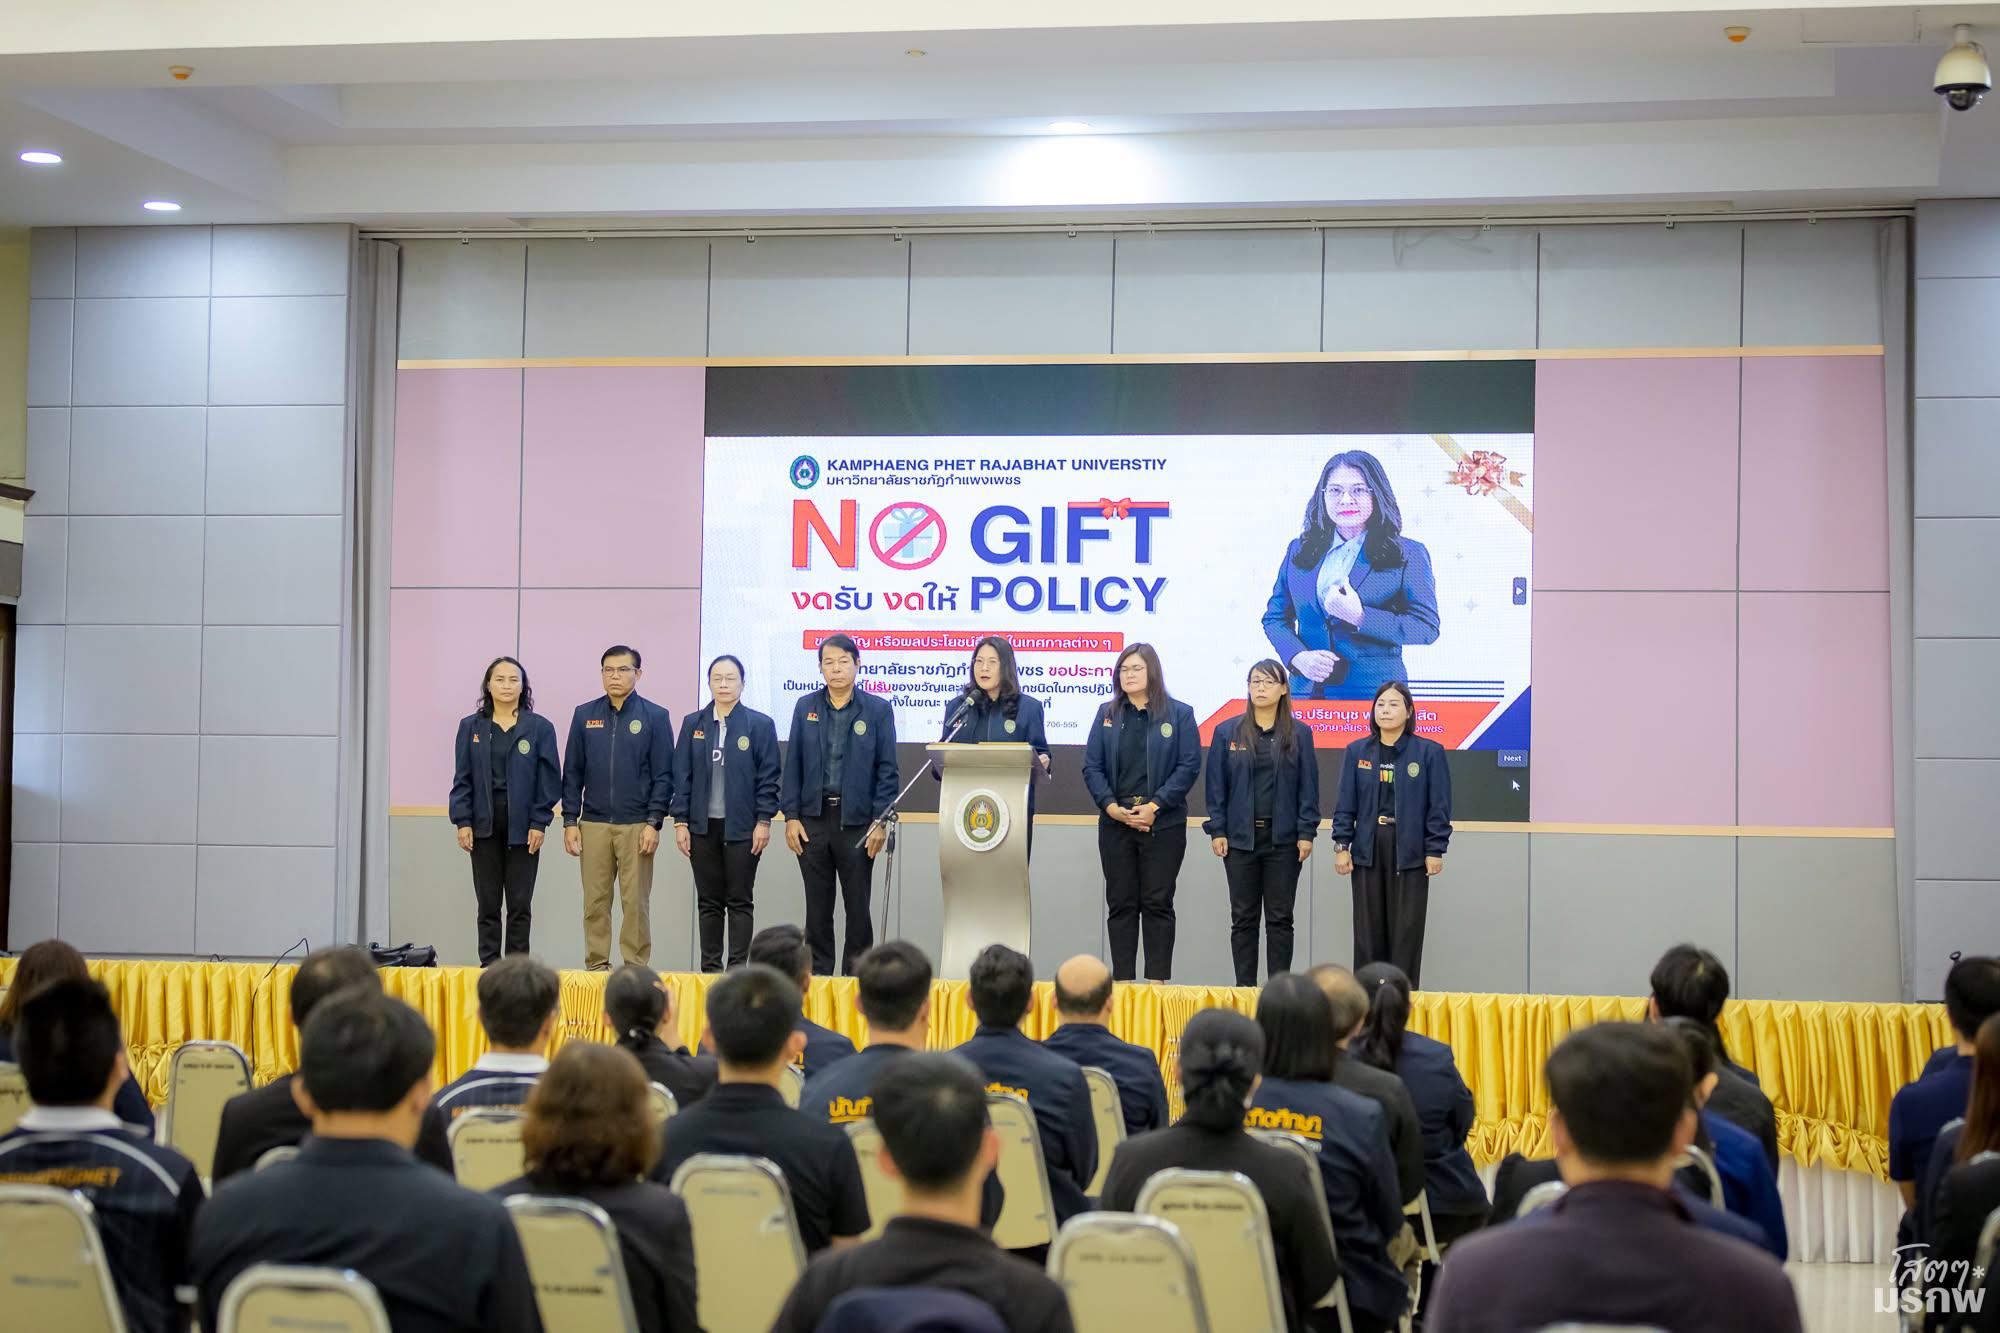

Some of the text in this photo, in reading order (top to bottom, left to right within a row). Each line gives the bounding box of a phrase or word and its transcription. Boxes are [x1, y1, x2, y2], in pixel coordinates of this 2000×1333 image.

[827, 458, 1168, 471] KAMPHAENG PHET RAJABHAT UNIVERSTIY
[826, 474, 1021, 488] มหาวิทยาลัยราชภัฏกำแพงเพชร
[970, 498, 1171, 565] GIFT
[791, 576, 1168, 615] งดรับ งดให้ POLICY
